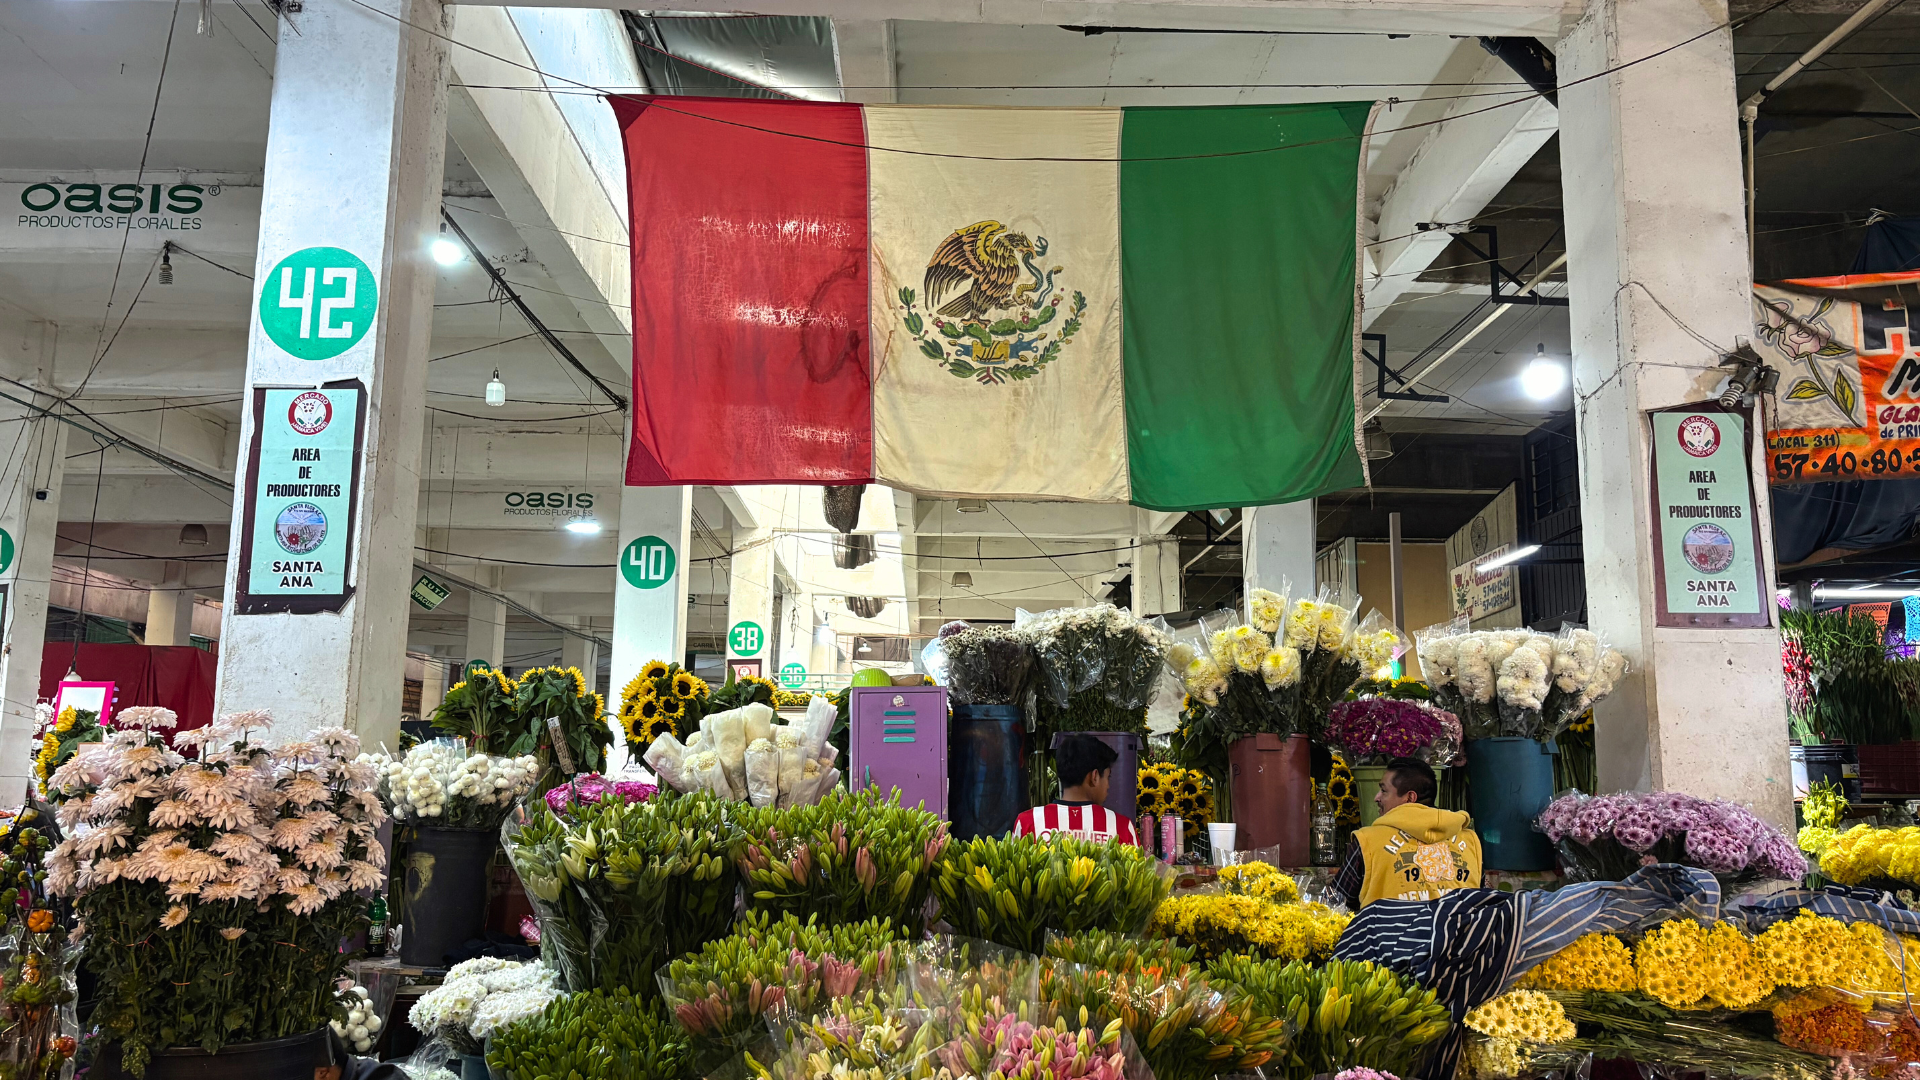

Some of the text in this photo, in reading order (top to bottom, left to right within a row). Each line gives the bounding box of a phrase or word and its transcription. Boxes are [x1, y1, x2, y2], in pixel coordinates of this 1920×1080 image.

[18, 215, 202, 230] PRODUCTOS FLORALES
[279, 267, 357, 339] 42
[294, 393, 329, 405] MERCADO
[1879, 405, 1920, 425] GLA
[1681, 416, 1716, 429] MERCADO
[1880, 424, 1920, 438] de PRI
[292, 448, 321, 461] AREA
[298, 466, 312, 479] DE
[1688, 470, 1717, 483] AREA
[266, 484, 341, 497] PRODUCTORES
[1697, 487, 1711, 500] DE
[504, 508, 593, 517] PRODUCTOS FLORALES
[1669, 505, 1742, 518] PRODUCTORES
[272, 561, 324, 573] SANTA
[630, 545, 666, 580] 40
[279, 575, 314, 588] ANA
[421, 578, 445, 597] RUTA
[1686, 580, 1738, 592] SANTA
[1696, 594, 1730, 607] ANA
[734, 628, 758, 650] 38
[784, 667, 803, 685] 36
[1404, 867, 1470, 882] 19 87
[1398, 889, 1430, 901] NEW
